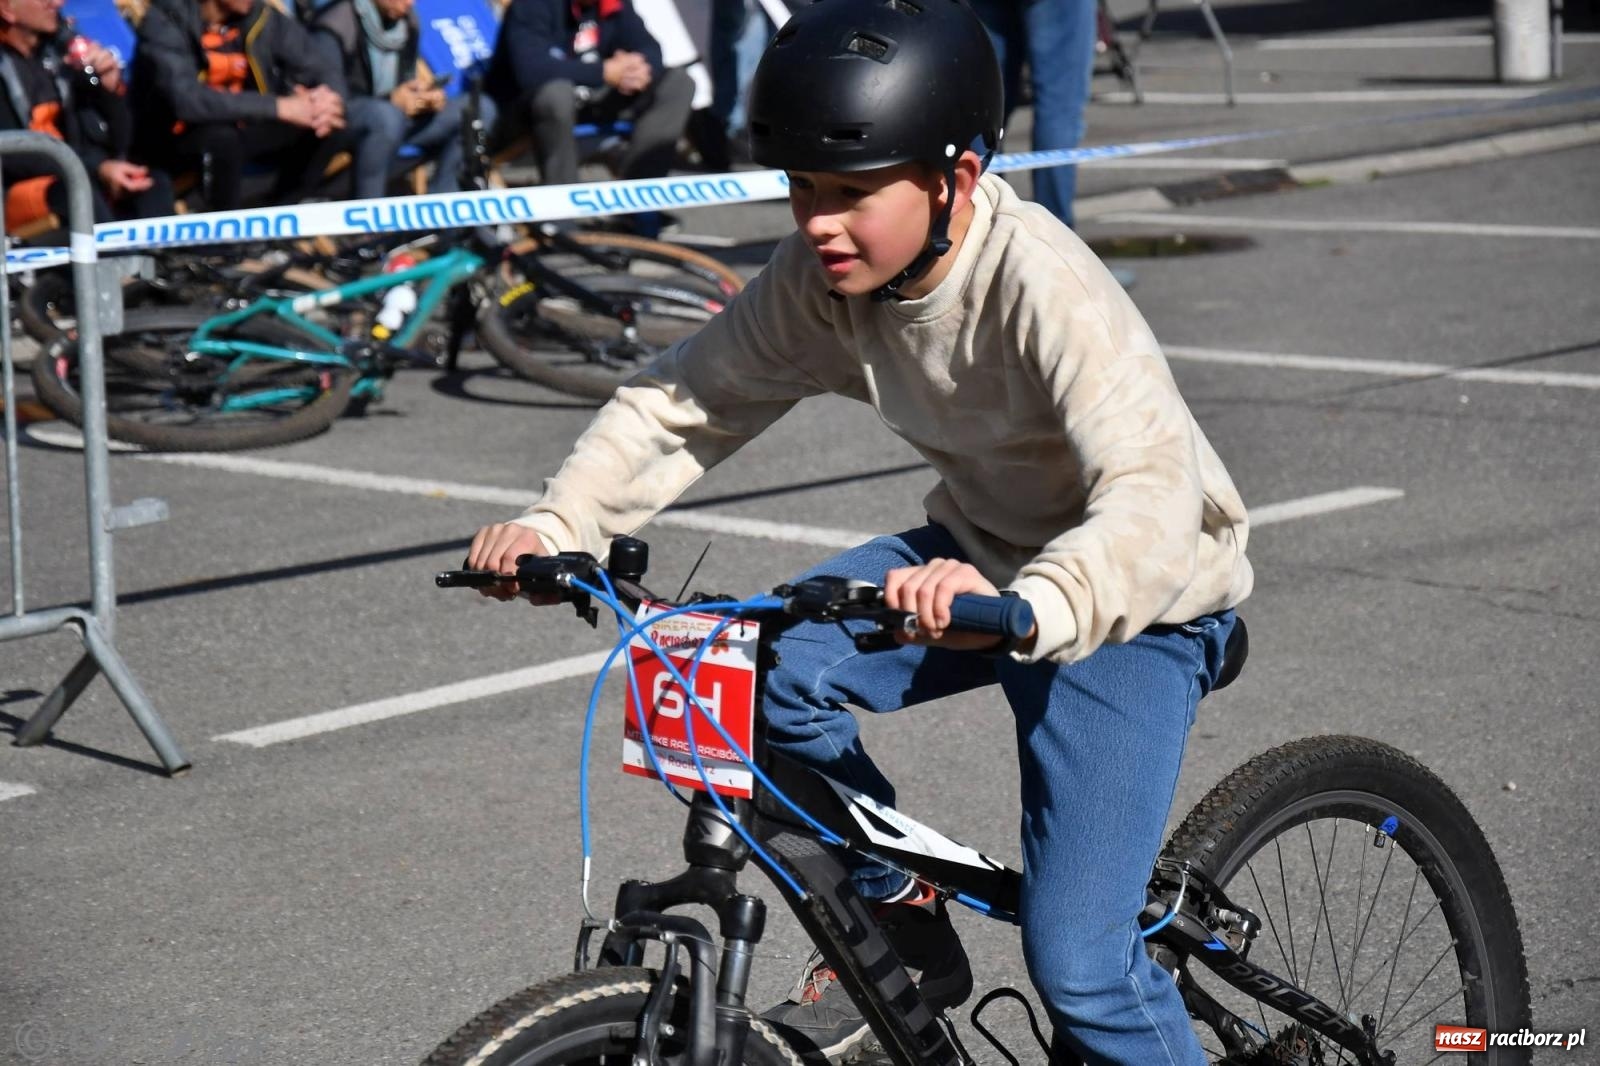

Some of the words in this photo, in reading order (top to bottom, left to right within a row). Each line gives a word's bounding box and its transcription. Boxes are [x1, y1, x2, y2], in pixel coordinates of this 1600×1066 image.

[343, 194, 534, 232] SHIMANO
[568, 178, 748, 213] SHIMANO
[652, 671, 722, 725] 64
